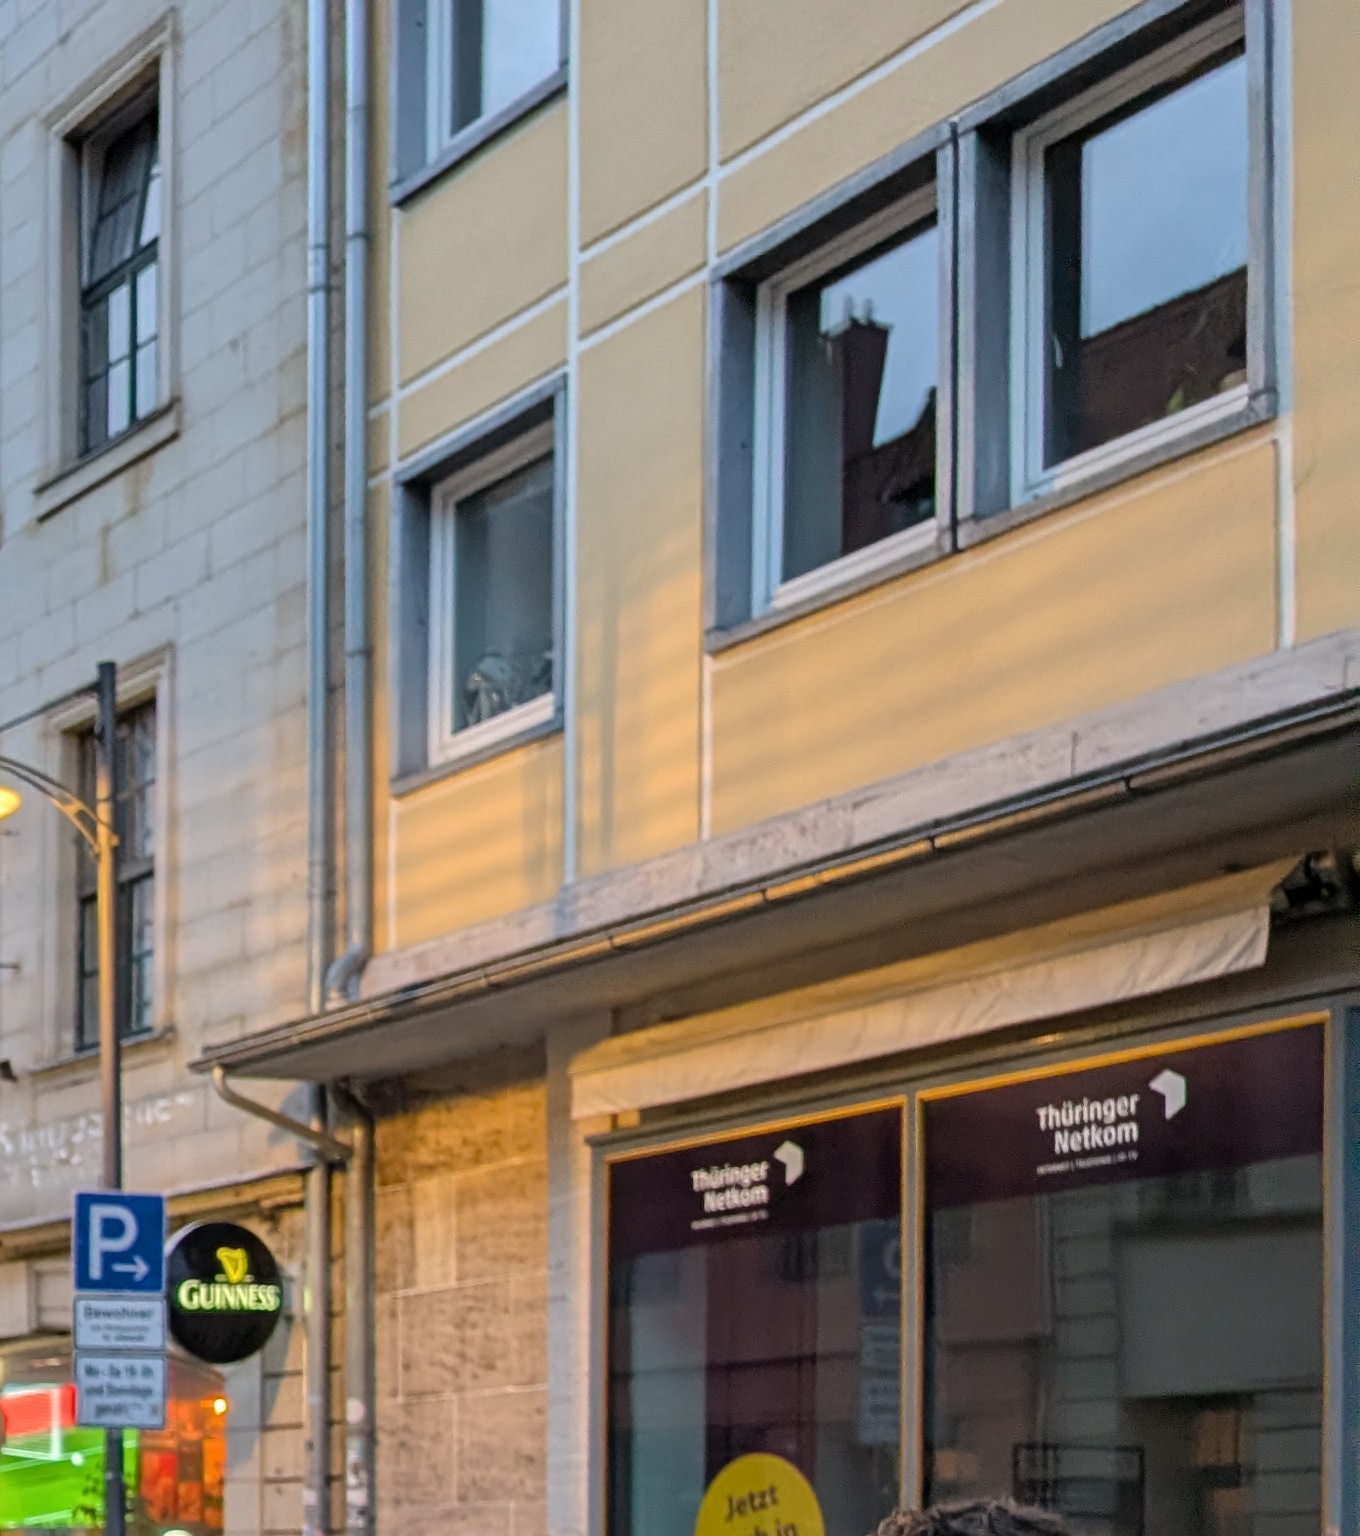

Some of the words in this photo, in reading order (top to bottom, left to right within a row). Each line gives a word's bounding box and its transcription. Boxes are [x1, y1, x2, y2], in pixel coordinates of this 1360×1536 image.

[1037, 1094, 1140, 1132] Thüringer
[1054, 1122, 1140, 1155] Netkom
[690, 1161, 769, 1192] Thüringer
[703, 1185, 769, 1213] Netkom
[88, 1203, 138, 1280] P
[178, 1278, 280, 1311] GUINNESS
[724, 1484, 779, 1522] Jetzt
